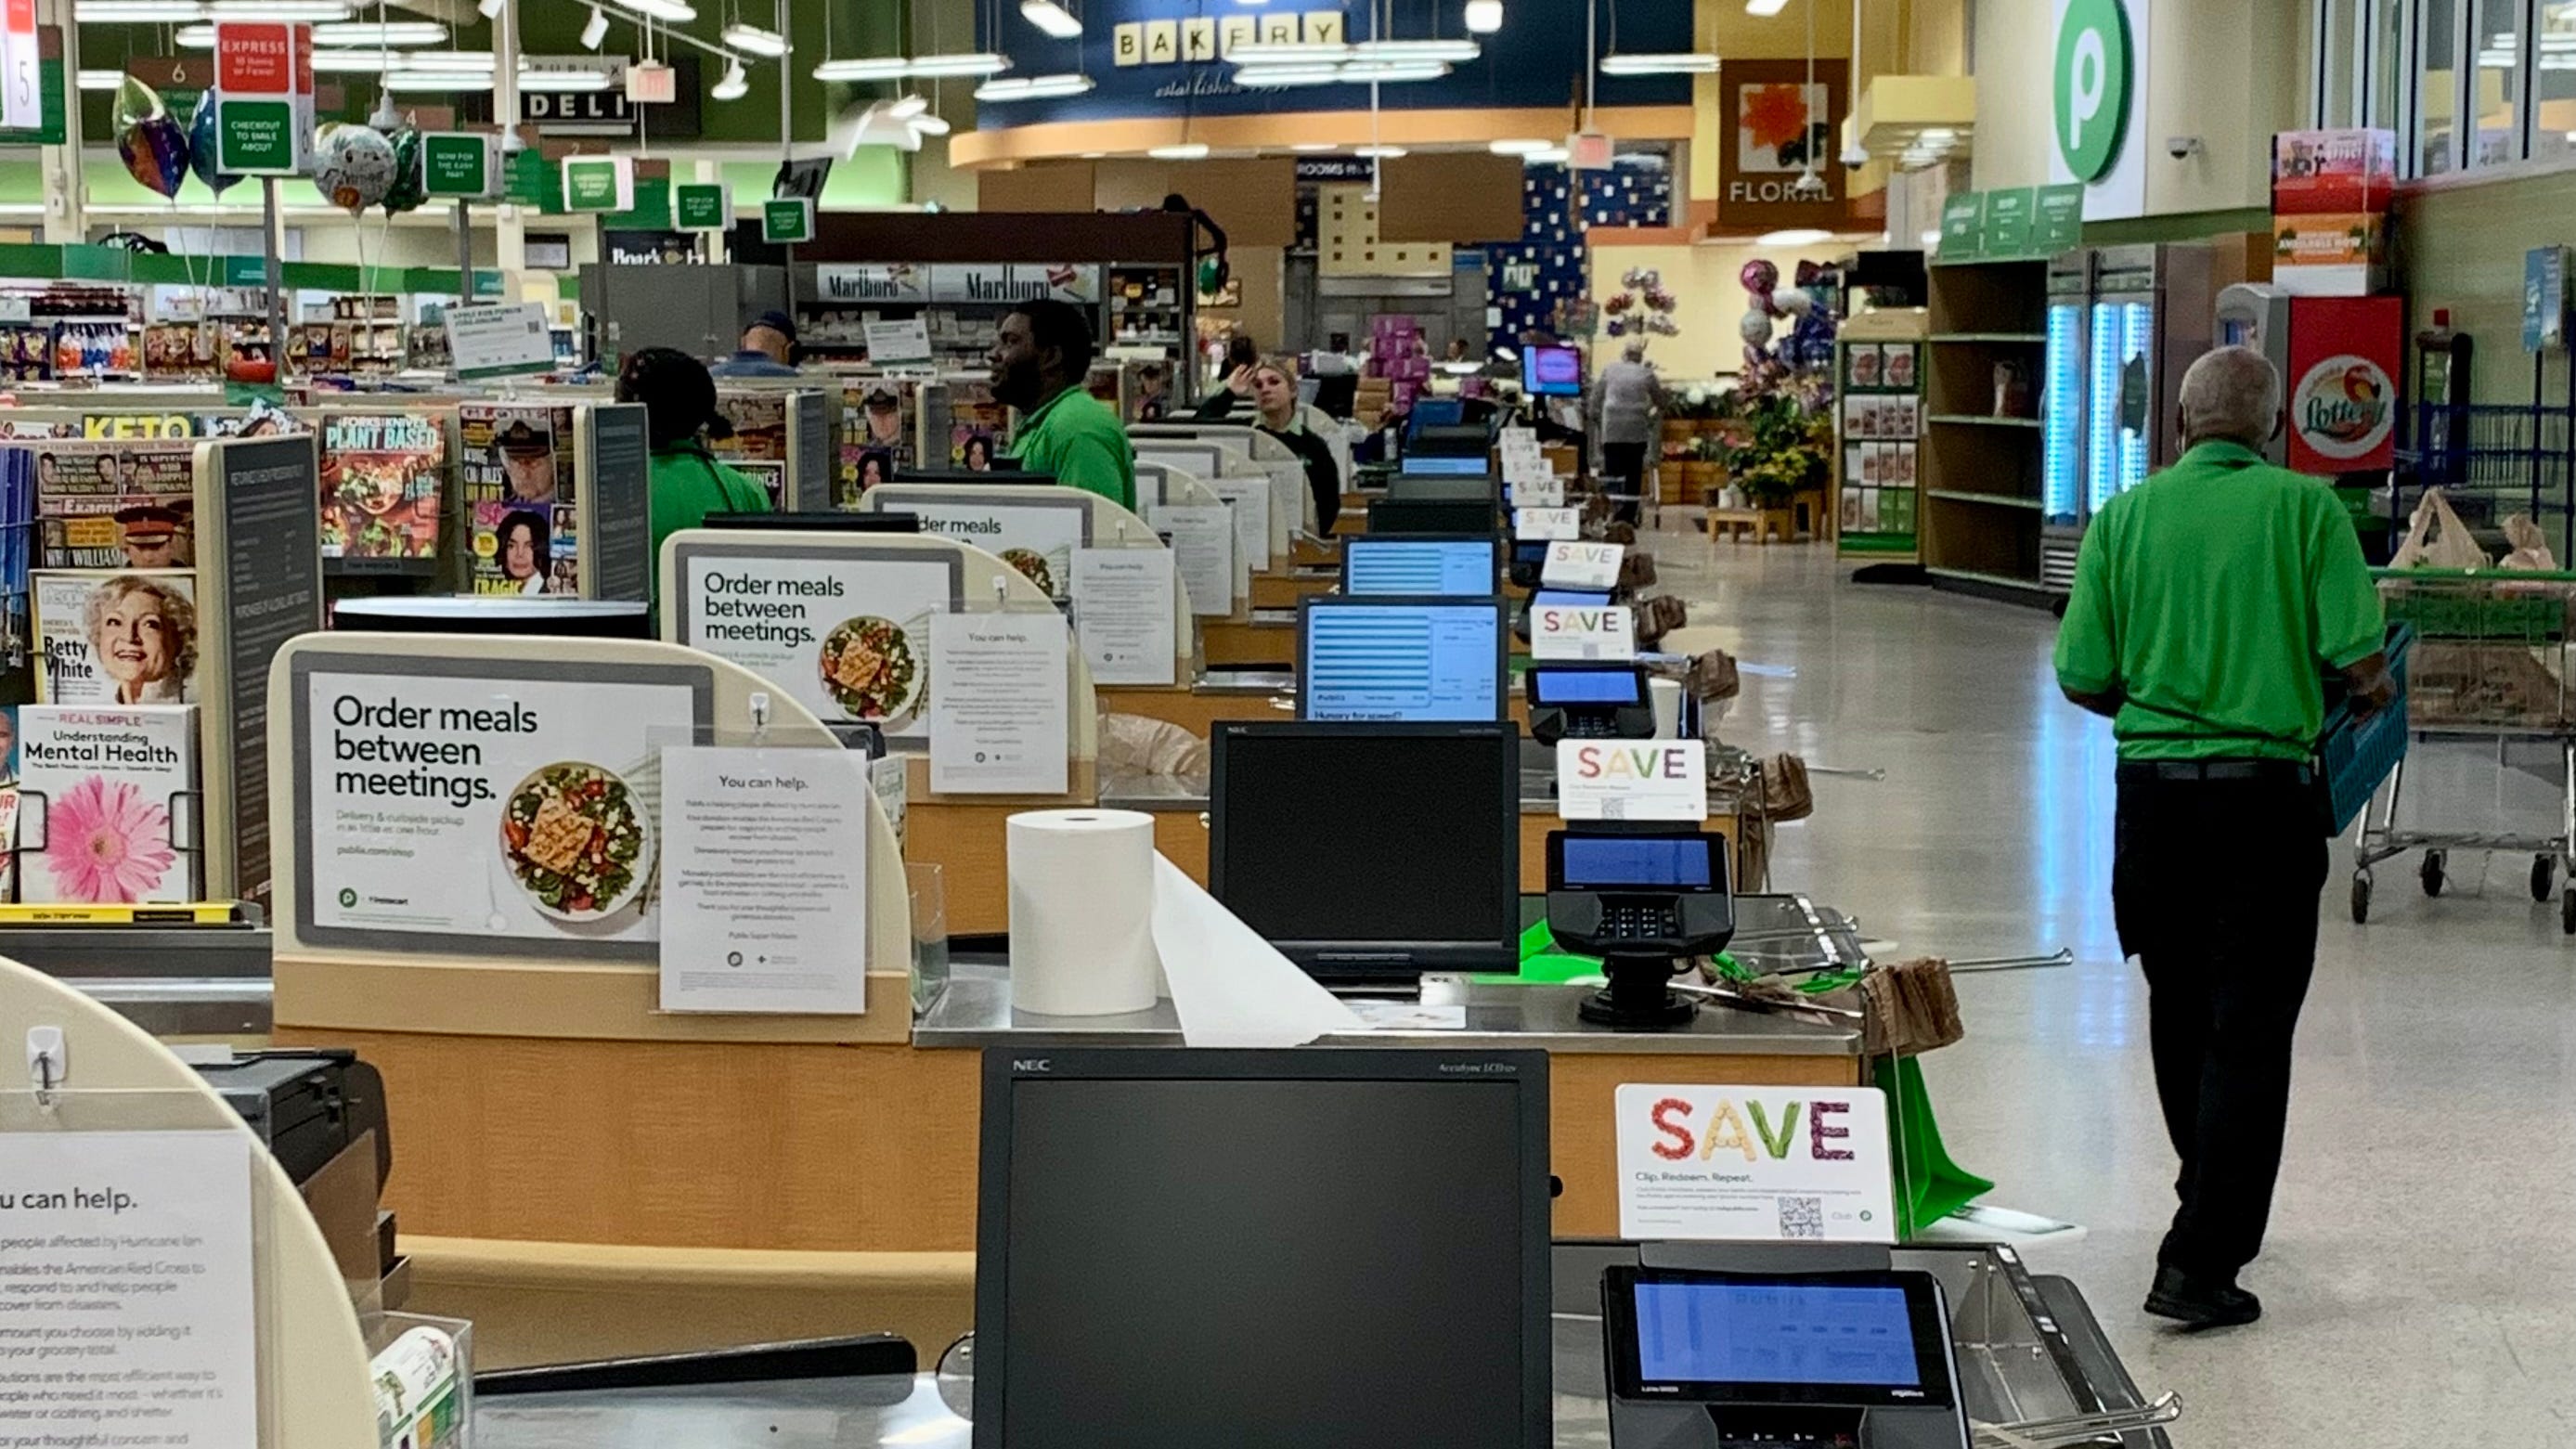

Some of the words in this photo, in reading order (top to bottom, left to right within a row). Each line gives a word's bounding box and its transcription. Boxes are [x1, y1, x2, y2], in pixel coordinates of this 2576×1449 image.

[221, 40, 286, 55] EXPRESS
[1120, 22, 1334, 56] BAKERY
[19, 60, 30, 108] 5
[172, 64, 187, 84] 6
[529, 94, 625, 117] DELI
[230, 121, 281, 130] CHECKOUT
[236, 132, 250, 140] TO
[251, 132, 278, 141] SMILE
[240, 143, 273, 151] ABOUT
[1728, 181, 1834, 202] FLORAL
[828, 268, 900, 299] Marlboro
[965, 263, 1051, 301] Marlboro
[83, 416, 191, 441] KETO
[326, 426, 382, 450] PLANT
[383, 427, 438, 450] BASED
[950, 517, 1003, 535] meals
[705, 572, 771, 594] Order
[777, 576, 845, 597] meals
[705, 596, 807, 619] between
[1544, 611, 1620, 632] SAVE
[705, 619, 817, 648] meetings.
[44, 636, 88, 662] Betty
[45, 658, 93, 679] White
[58, 713, 94, 724] REAL
[96, 714, 142, 727] SIMPLE
[333, 694, 433, 730] Order
[439, 702, 538, 733] meals
[53, 730, 149, 748] Understanding
[335, 729, 482, 766] between
[24, 742, 99, 761] Mental
[105, 744, 179, 764] Health
[1577, 746, 1688, 780] SAVE
[335, 767, 497, 809] meetings.
[718, 775, 745, 788] You
[748, 779, 772, 788] can
[775, 777, 809, 791] help.
[1013, 1059, 1051, 1072] NEC
[1651, 1098, 1855, 1162] SAVE
[1635, 1171, 1660, 1184] Clip.
[1661, 1171, 1710, 1182] Redeem.
[1711, 1172, 1754, 1184] Repeat.
[21, 1193, 67, 1210] can
[73, 1186, 139, 1215] help.
[2, 1237, 45, 1250] people
[48, 1235, 100, 1248] affected
[120, 1236, 179, 1248] Hurricane
[43, 1263, 63, 1275] the
[65, 1261, 124, 1274] American
[127, 1262, 152, 1274] Red
[154, 1261, 190, 1274] Cross
[192, 1263, 206, 1274] to
[5, 1282, 57, 1295] respond
[75, 1281, 99, 1292] and
[101, 1281, 129, 1295] help
[132, 1282, 177, 1296] people
[34, 1299, 63, 1310] from
[44, 1328, 68, 1340] you
[69, 1326, 115, 1339] choose
[117, 1326, 133, 1340] by
[136, 1326, 181, 1339] adding
[7, 1347, 35, 1359] your
[37, 1347, 84, 1359] grocery
[44, 1374, 63, 1383] are
[66, 1371, 85, 1383] the
[88, 1372, 121, 1383] most
[175, 1372, 201, 1384] way
[202, 1371, 216, 1380] to
[32, 1391, 59, 1401] who
[61, 1391, 93, 1401] need
[35, 1410, 48, 1418] or
[50, 1407, 100, 1421] clothing
[105, 1408, 129, 1418] and
[14, 1437, 42, 1448] your
[44, 1434, 109, 1448] thoughtful
[110, 1436, 158, 1446] concern
[163, 1433, 188, 1444] and
